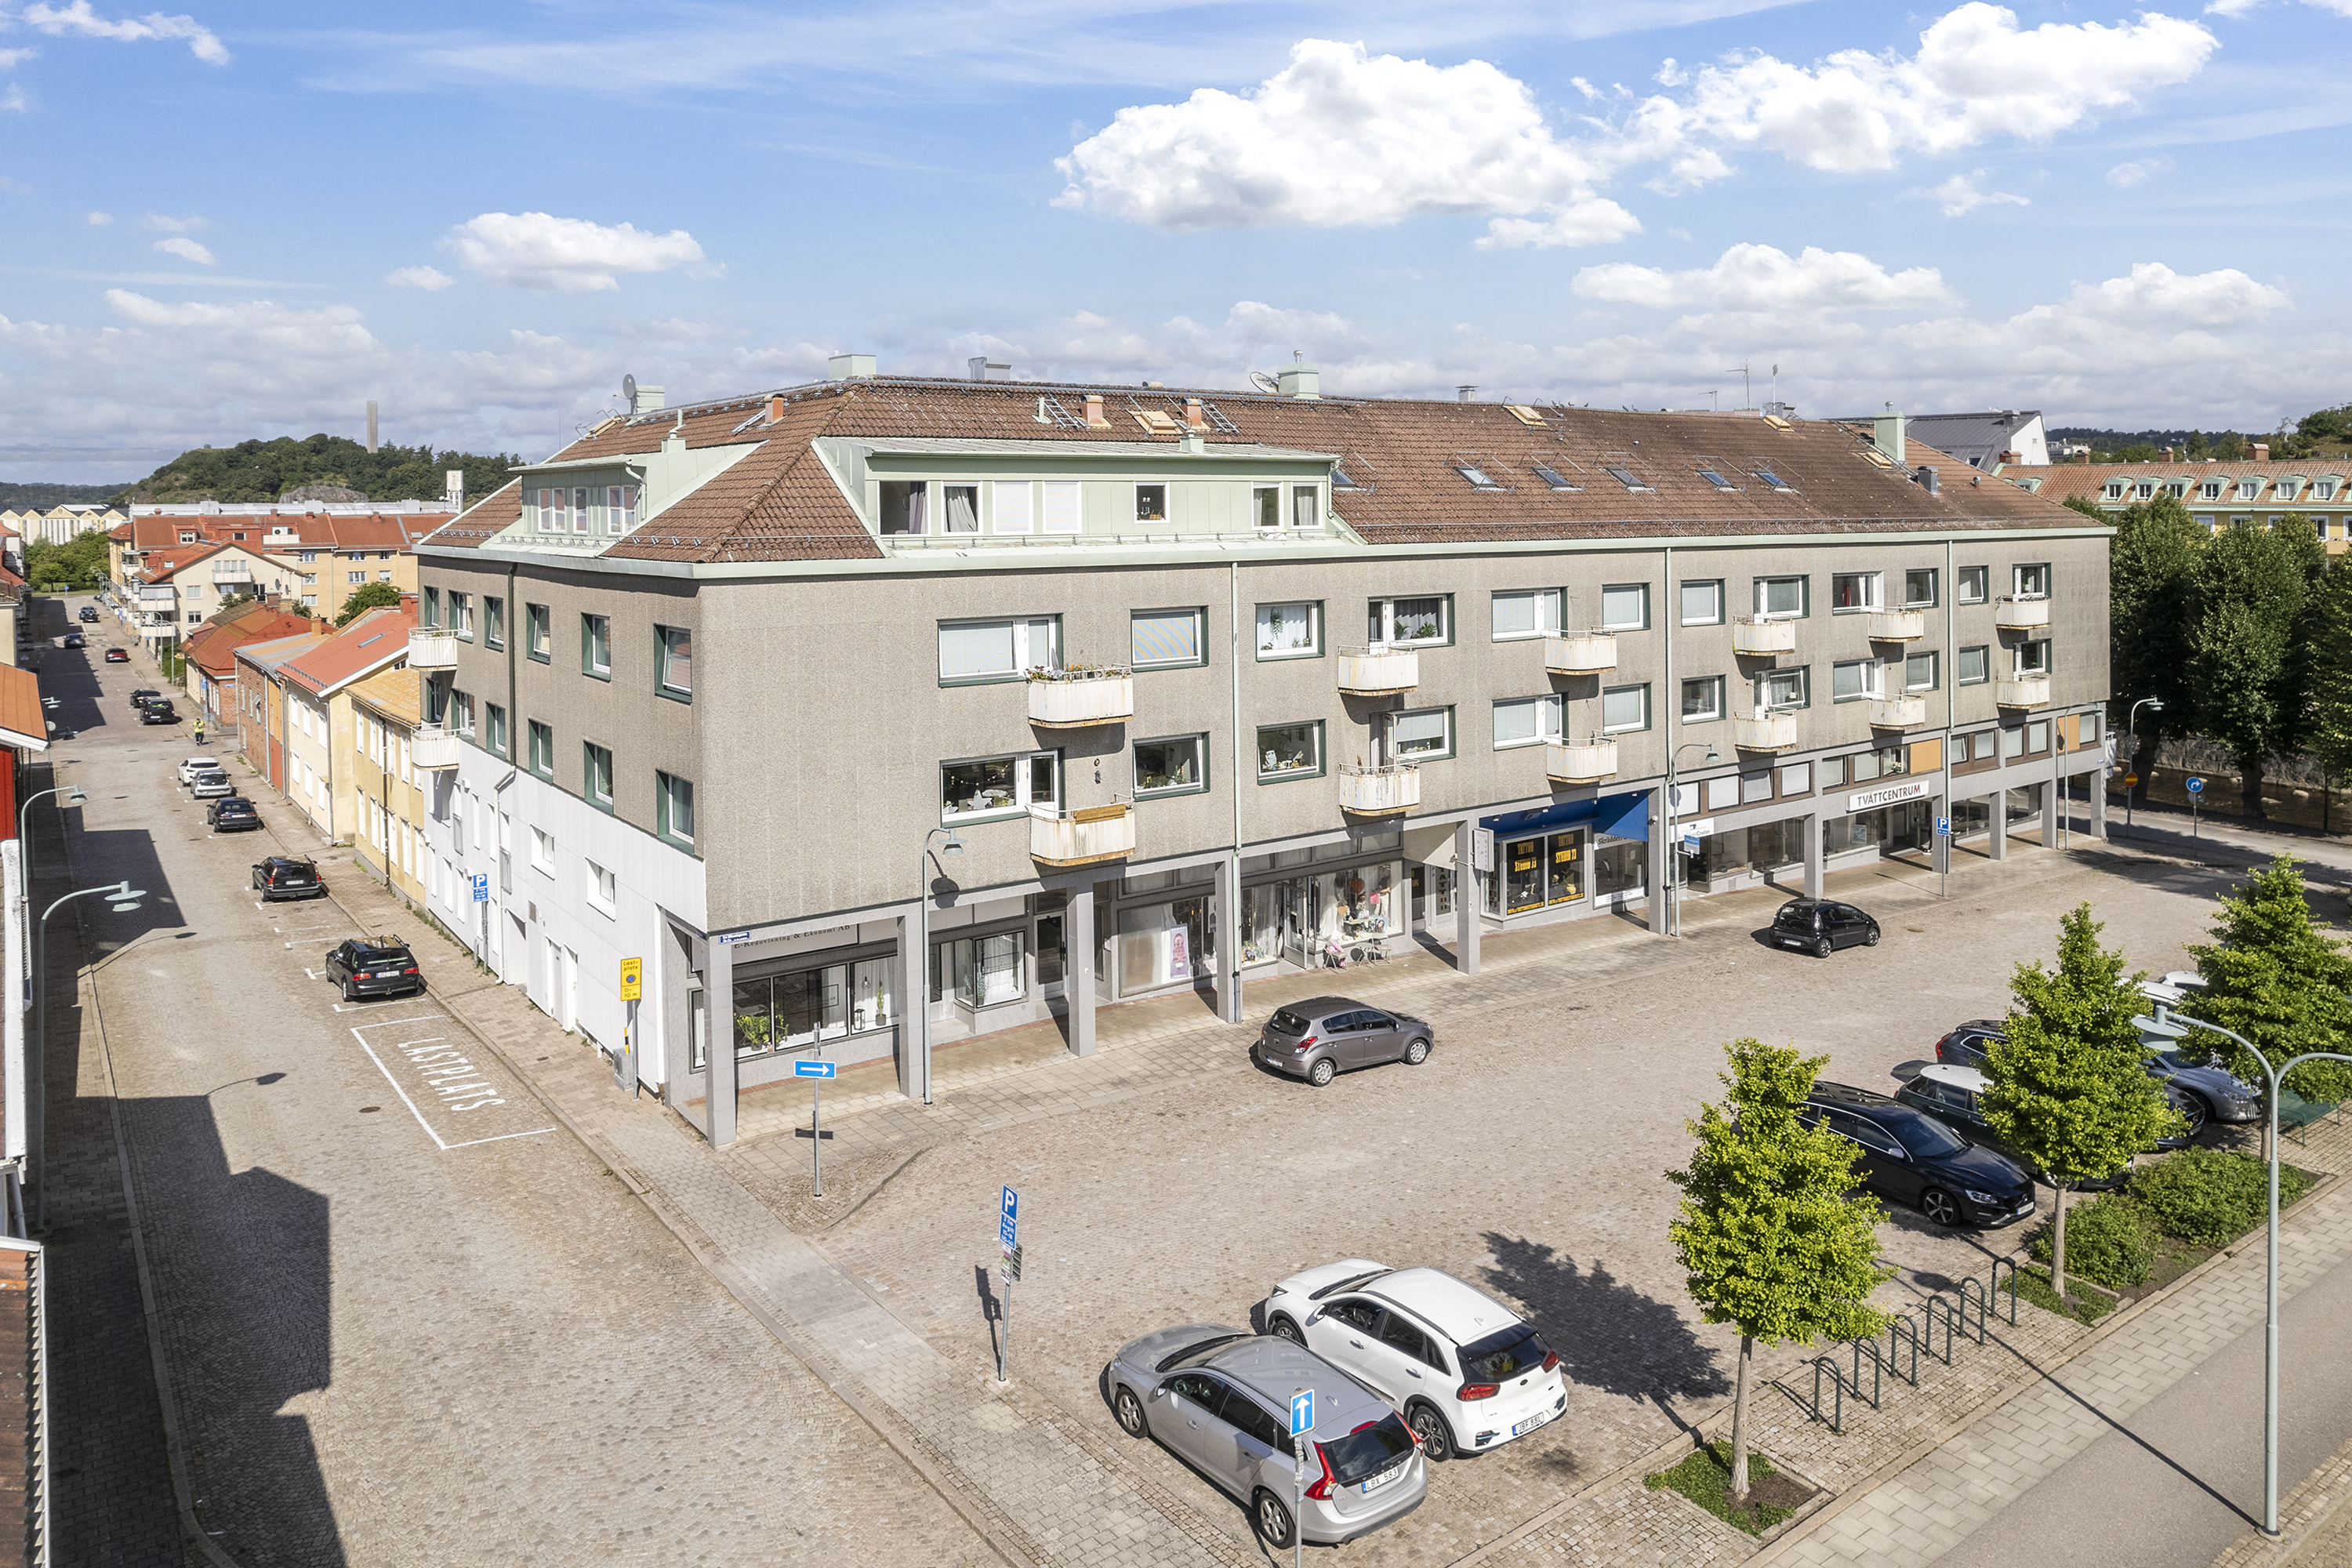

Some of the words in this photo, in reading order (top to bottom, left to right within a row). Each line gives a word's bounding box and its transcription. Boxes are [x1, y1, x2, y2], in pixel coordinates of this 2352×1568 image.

[1857, 784, 1921, 807] TVÄTTCENTRUM
[1940, 818, 1947, 828] P
[1555, 849, 1571, 864] STUDIO
[1514, 858, 1531, 873] STUDIO
[476, 874, 486, 887] P
[804, 927, 836, 938] Ekonomi
[397, 1037, 506, 1112] LASTPLATS
[1004, 1189, 1014, 1213] P
[1367, 1477, 1381, 1490] LBX
[1384, 1468, 1397, 1482] 583
